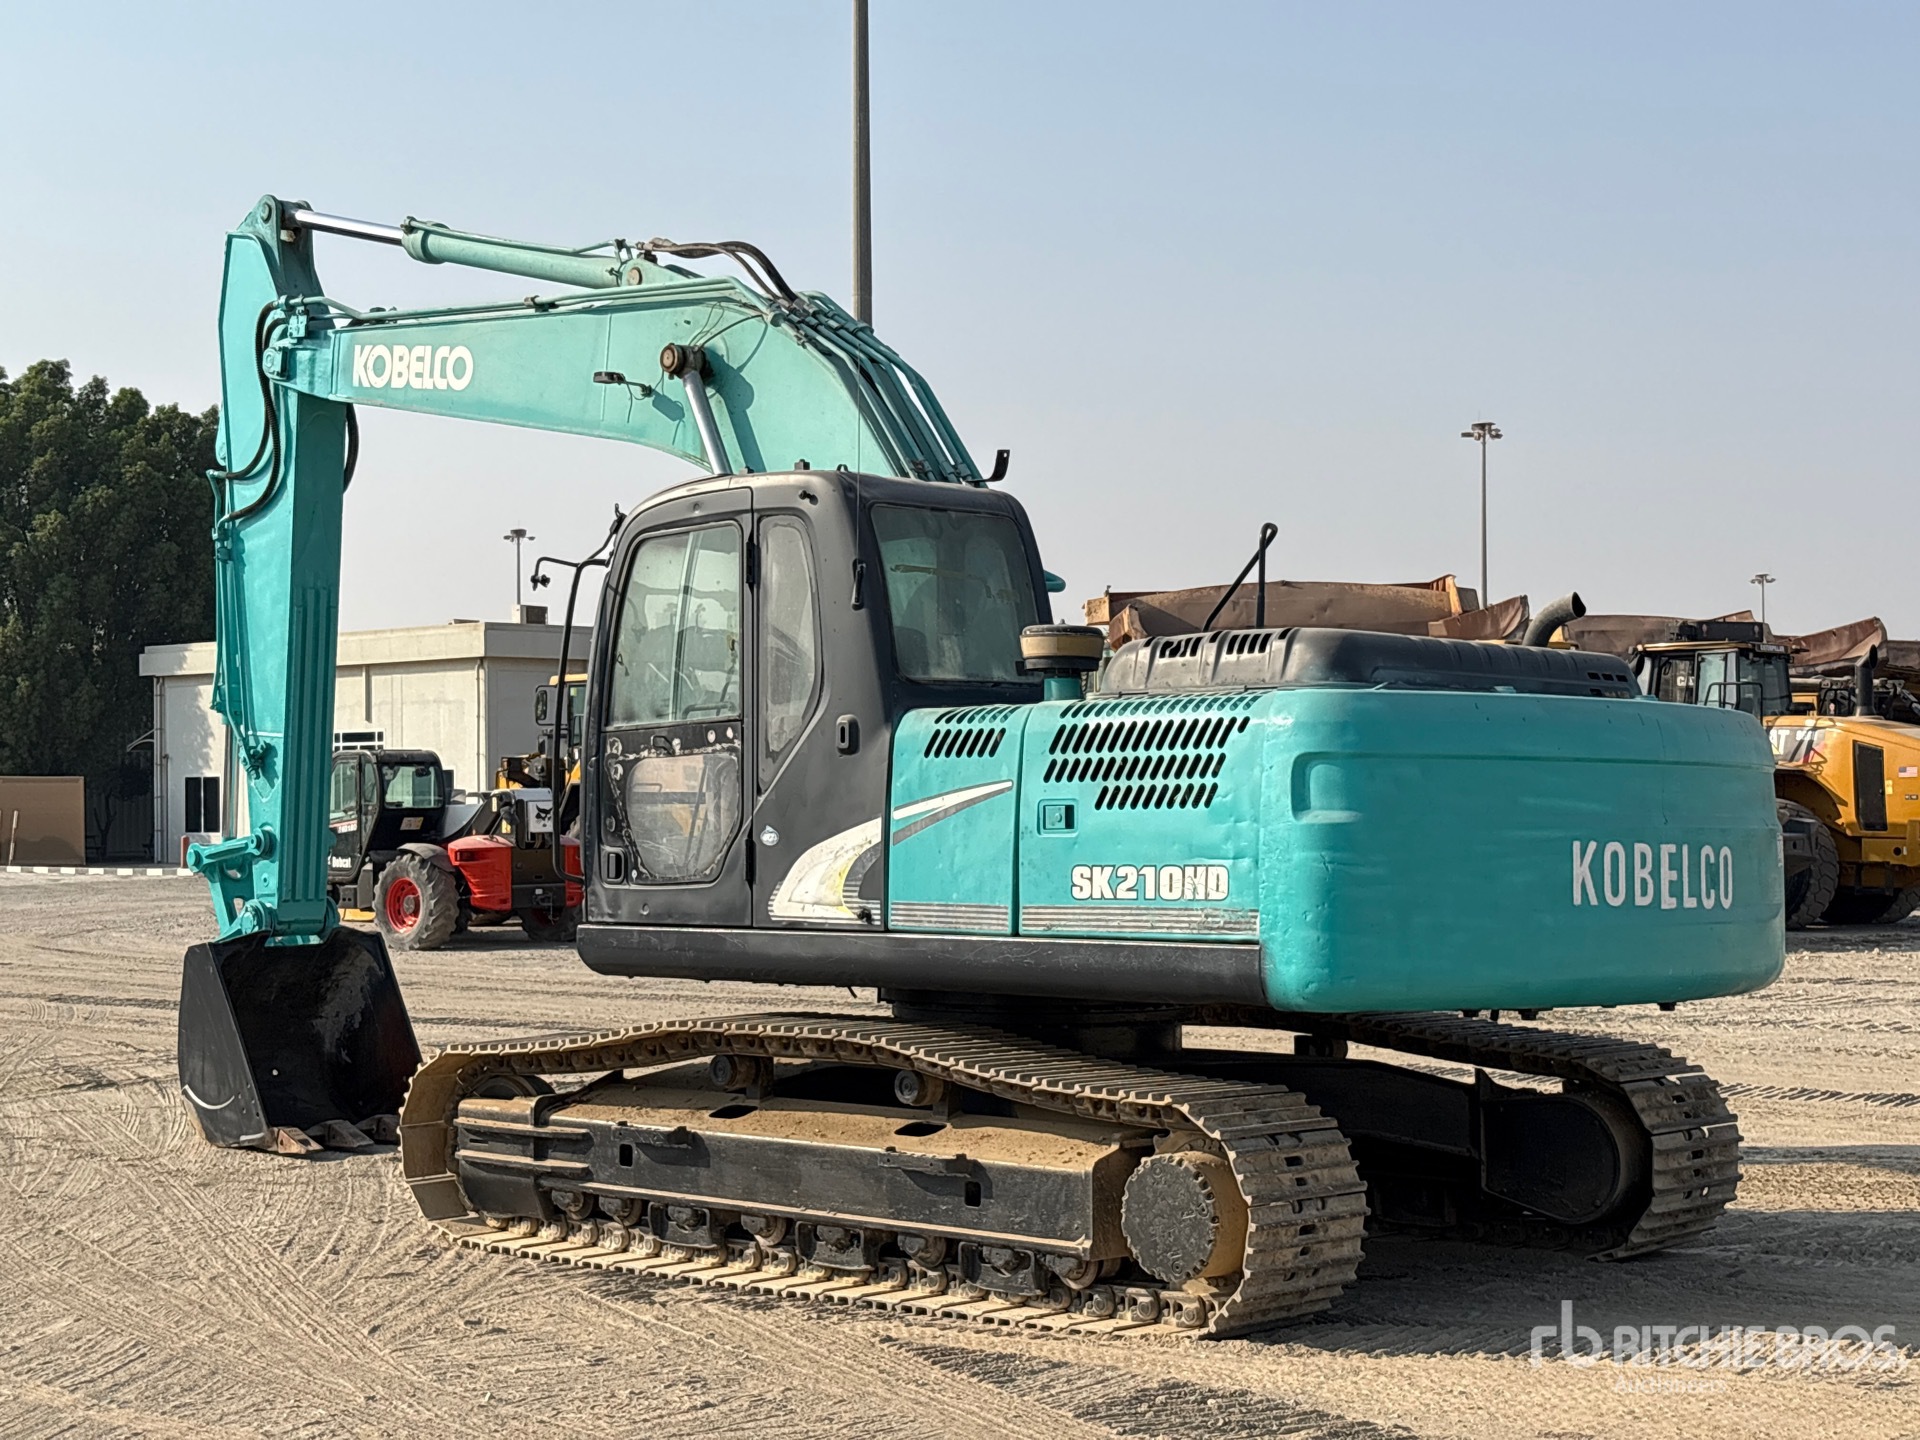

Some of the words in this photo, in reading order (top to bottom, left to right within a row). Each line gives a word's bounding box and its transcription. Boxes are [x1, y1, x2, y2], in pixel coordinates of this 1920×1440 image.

[352, 344, 474, 391] KOBELCO
[1768, 729, 1790, 755] AT
[1071, 864, 1230, 901] SK210HD
[1572, 840, 1733, 910] KOBELCO
